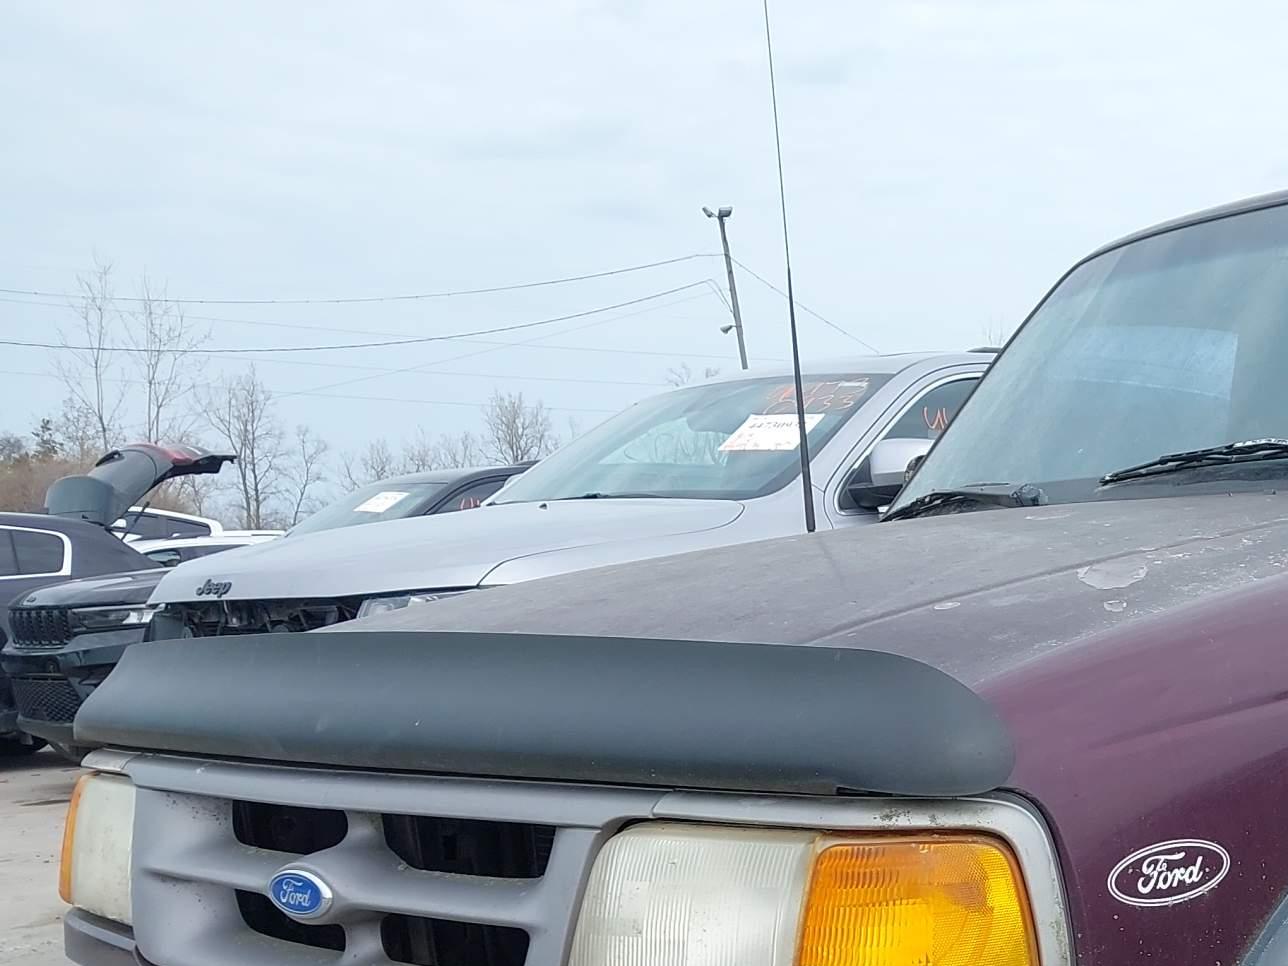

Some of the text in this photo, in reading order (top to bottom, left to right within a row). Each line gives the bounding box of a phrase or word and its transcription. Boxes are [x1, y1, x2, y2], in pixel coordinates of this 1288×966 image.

[196, 579, 232, 599] Jeep
[1137, 851, 1204, 894] Ford
[279, 878, 312, 907] Ford
